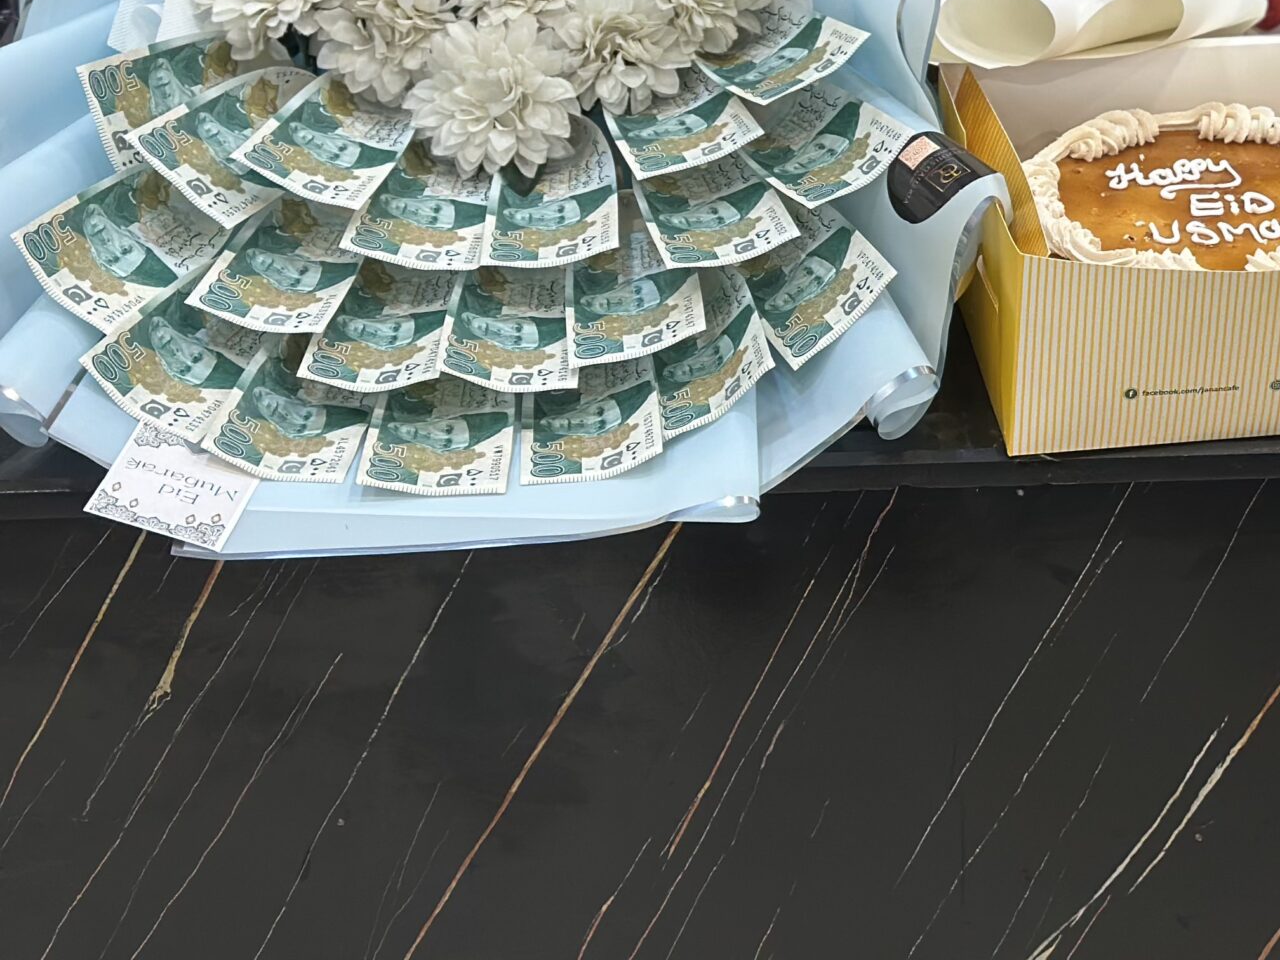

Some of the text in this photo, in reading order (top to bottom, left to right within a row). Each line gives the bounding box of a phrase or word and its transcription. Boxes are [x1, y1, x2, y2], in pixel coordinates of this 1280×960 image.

[88, 60, 141, 100] 500
[138, 120, 193, 158] 500
[244, 135, 293, 170] 500
[630, 143, 671, 172] 500
[786, 176, 836, 201] 500
[1105, 158, 1242, 200] Happy
[23, 214, 77, 262] 500
[351, 213, 393, 251] 500
[489, 229, 524, 261] 500
[660, 234, 701, 263] 500
[199, 268, 252, 311] 500
[443, 333, 480, 376] 500
[574, 321, 608, 359] 500
[774, 314, 819, 357] 500
[92, 331, 147, 382] 500
[307, 337, 351, 379] 500
[660, 388, 696, 431] 500
[213, 409, 261, 458] 500
[125, 456, 238, 501] Mubarak
[366, 442, 408, 483] 500
[530, 440, 566, 478] 500
[158, 483, 200, 505] Eid
